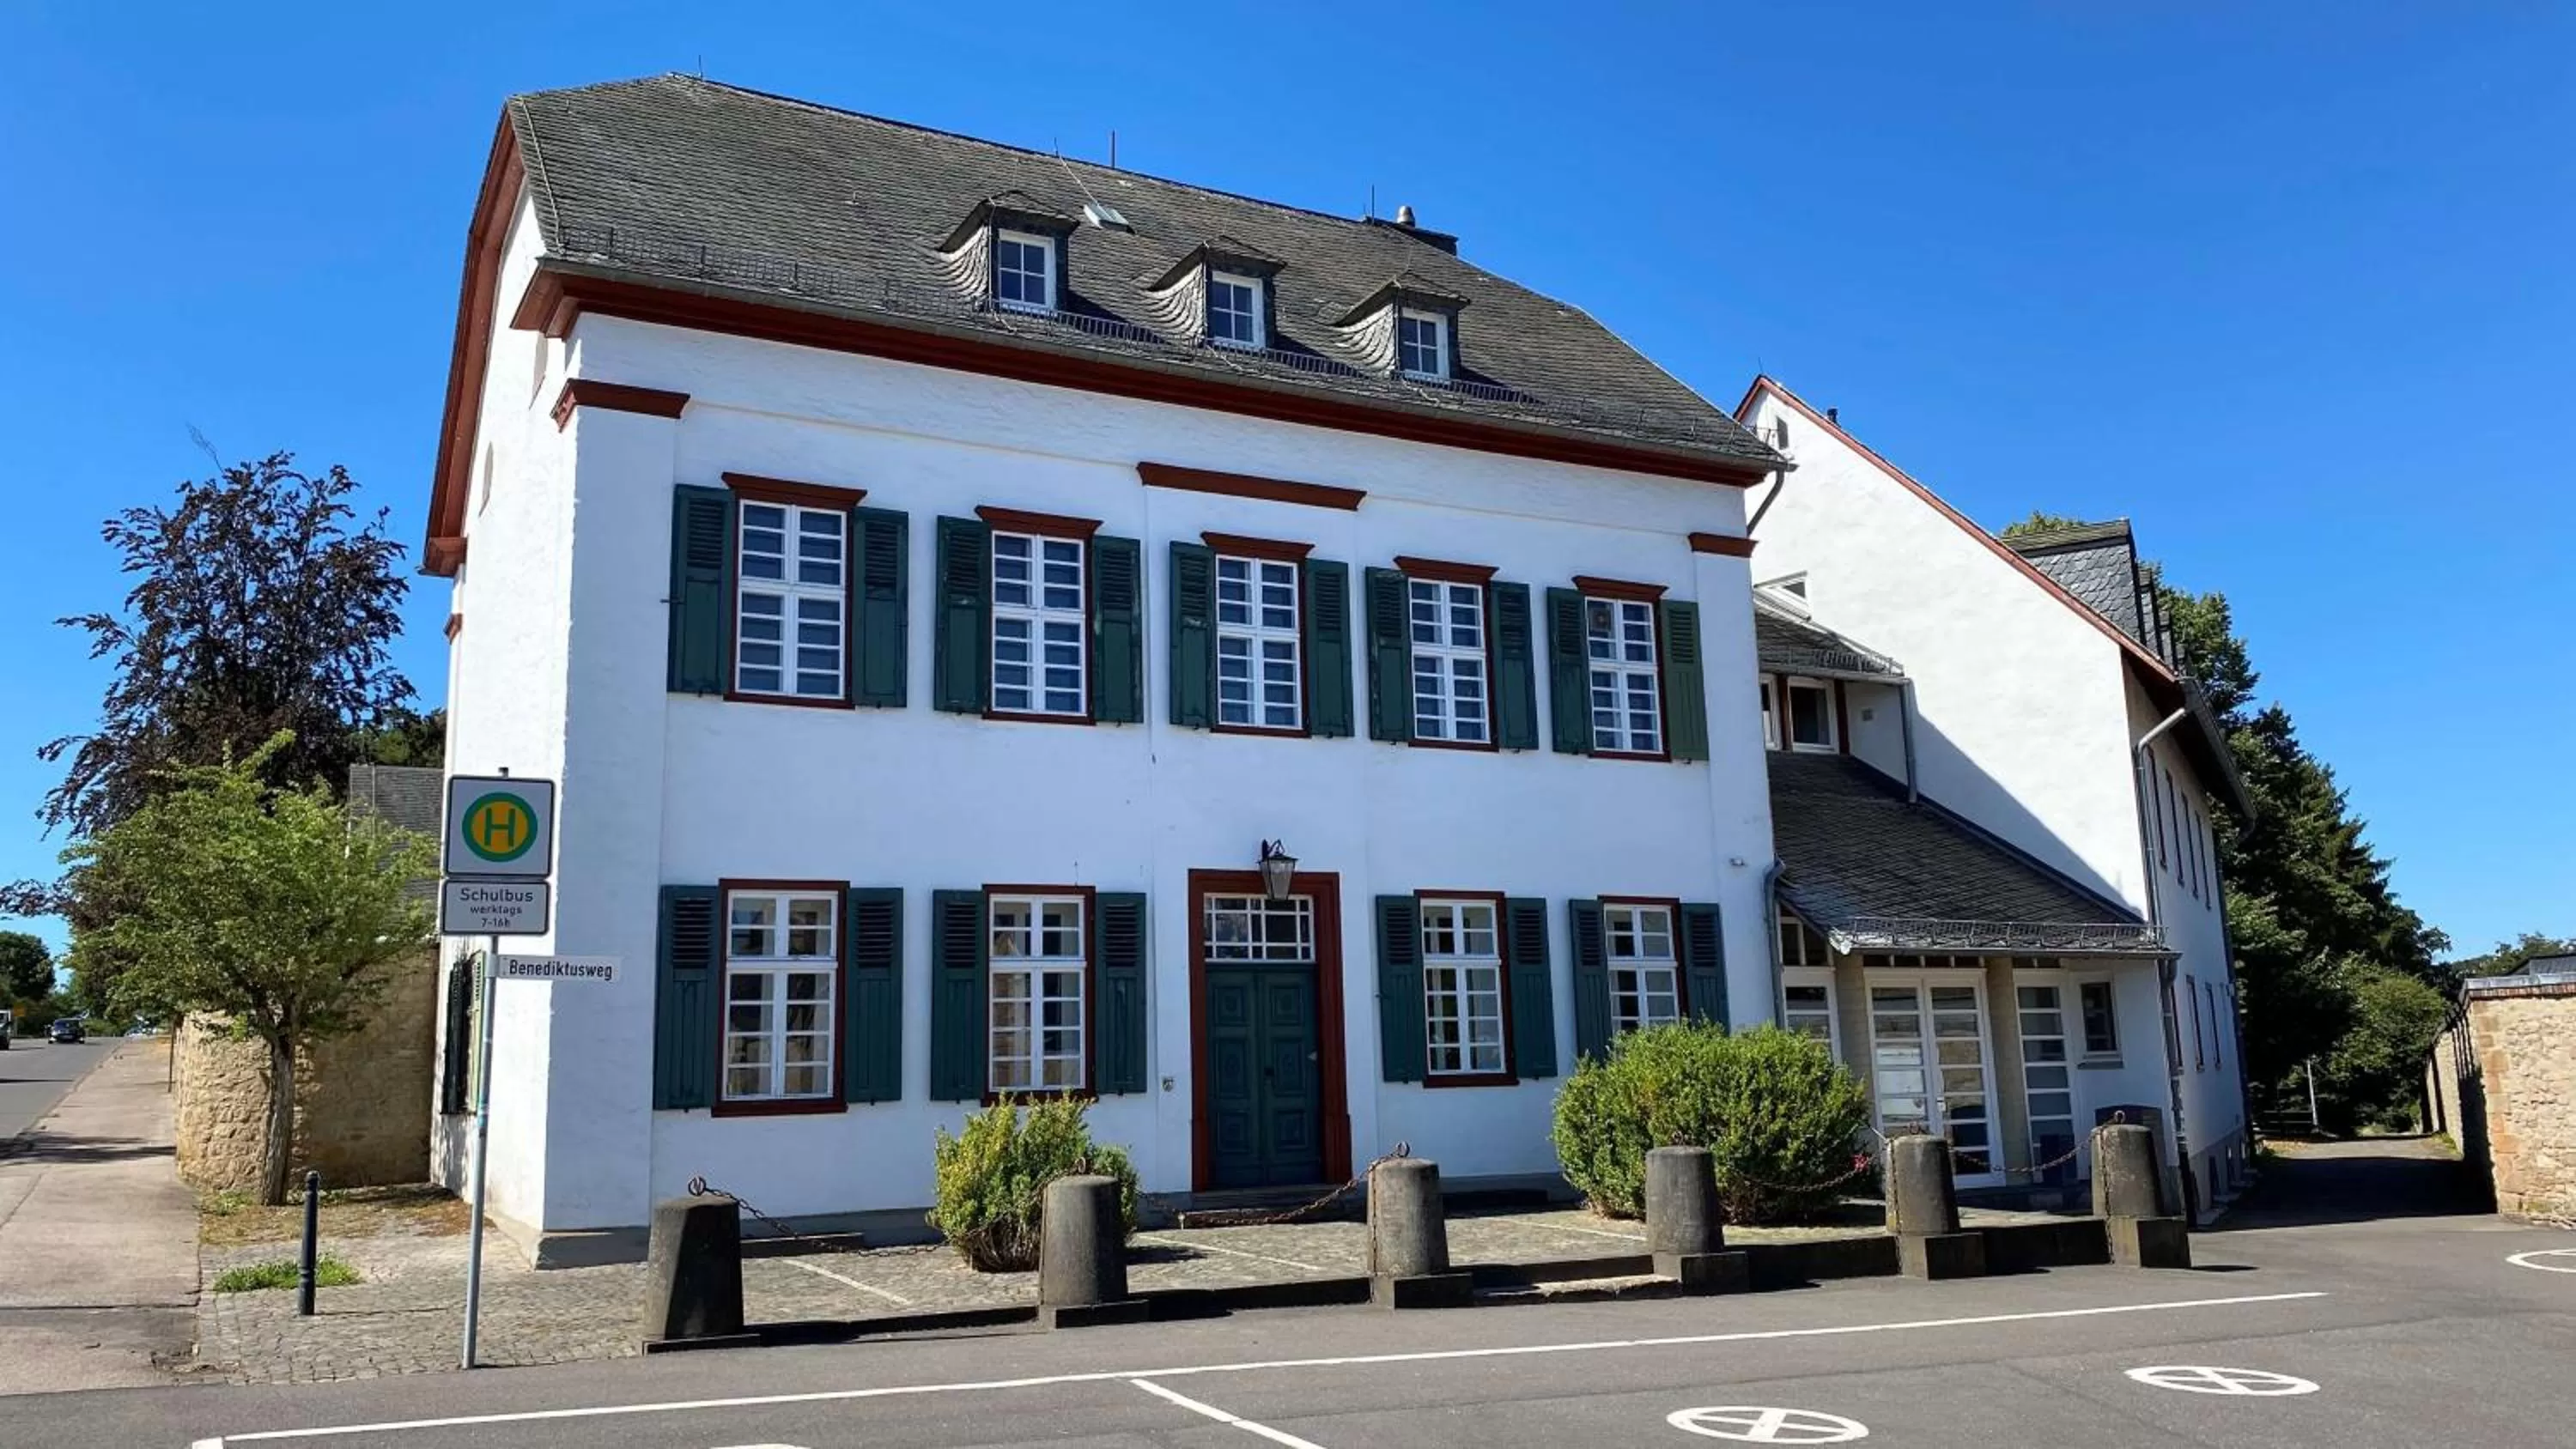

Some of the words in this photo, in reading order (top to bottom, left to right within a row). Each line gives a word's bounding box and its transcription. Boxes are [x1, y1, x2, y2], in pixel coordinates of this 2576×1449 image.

[483, 807, 515, 846] H
[459, 887, 533, 902] Schulbus
[470, 905, 523, 917] werktags
[481, 918, 511, 927] 7-16h
[509, 960, 612, 980] Benediktusweg
